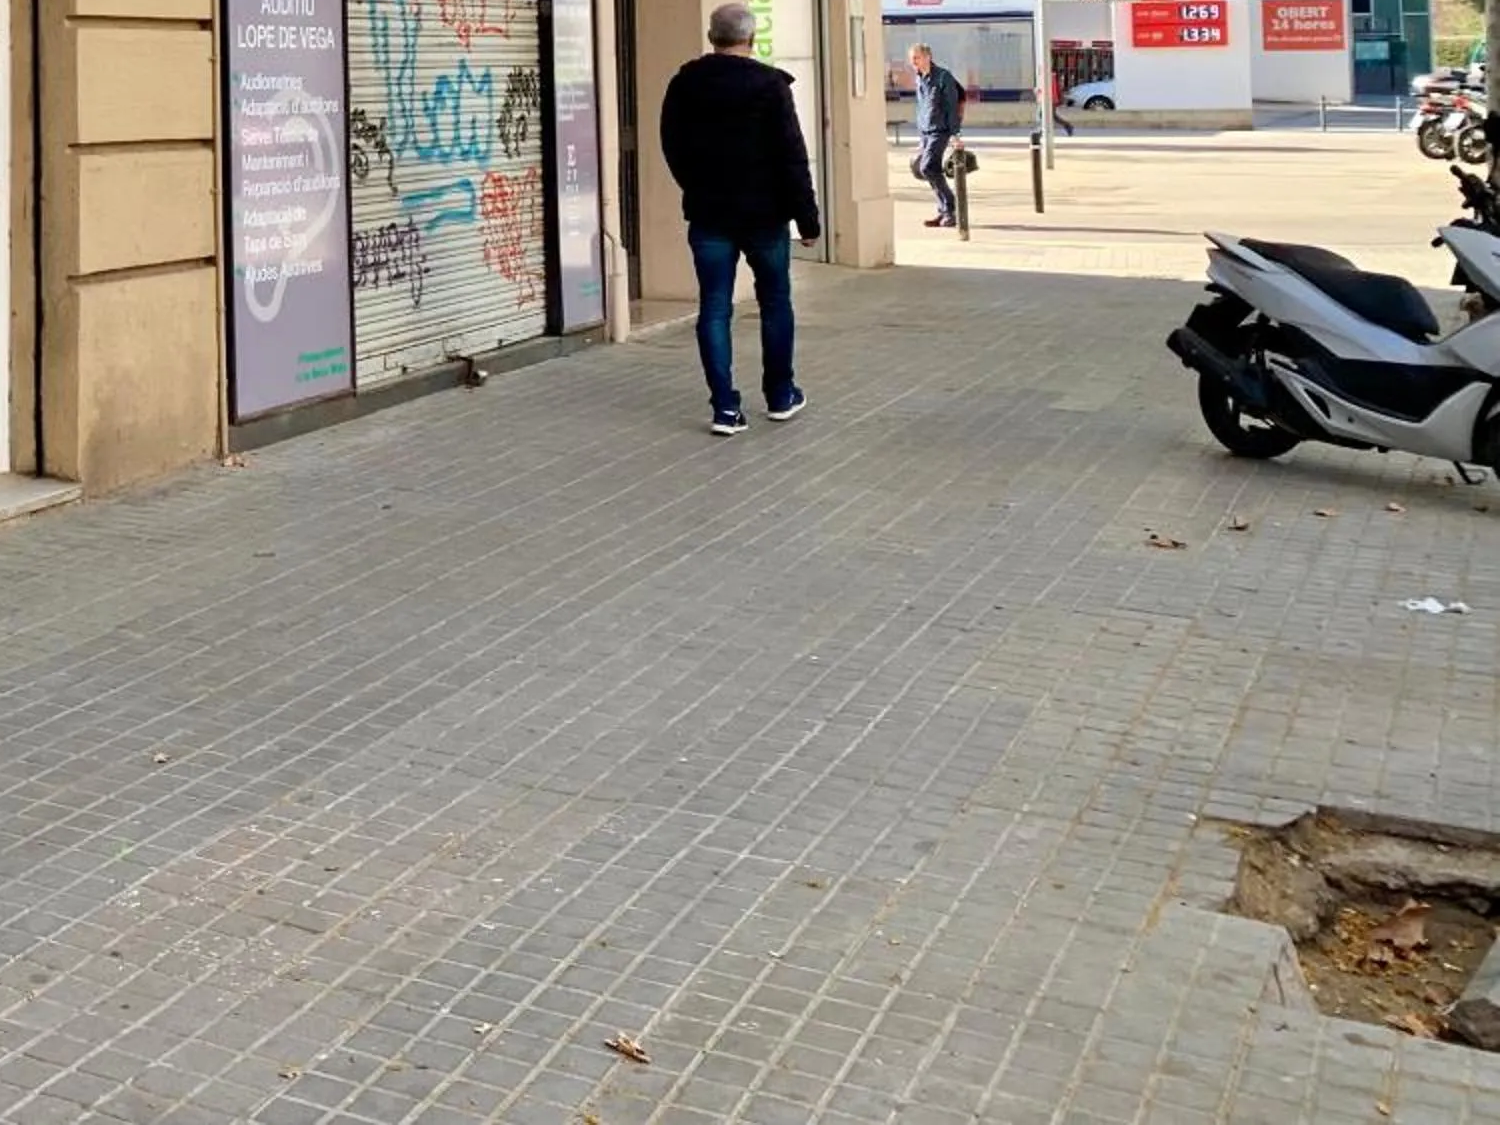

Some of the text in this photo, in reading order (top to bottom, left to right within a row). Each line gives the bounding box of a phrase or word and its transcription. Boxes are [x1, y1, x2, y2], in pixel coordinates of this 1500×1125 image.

[237, 25, 336, 50] LOPE DE VEGA
